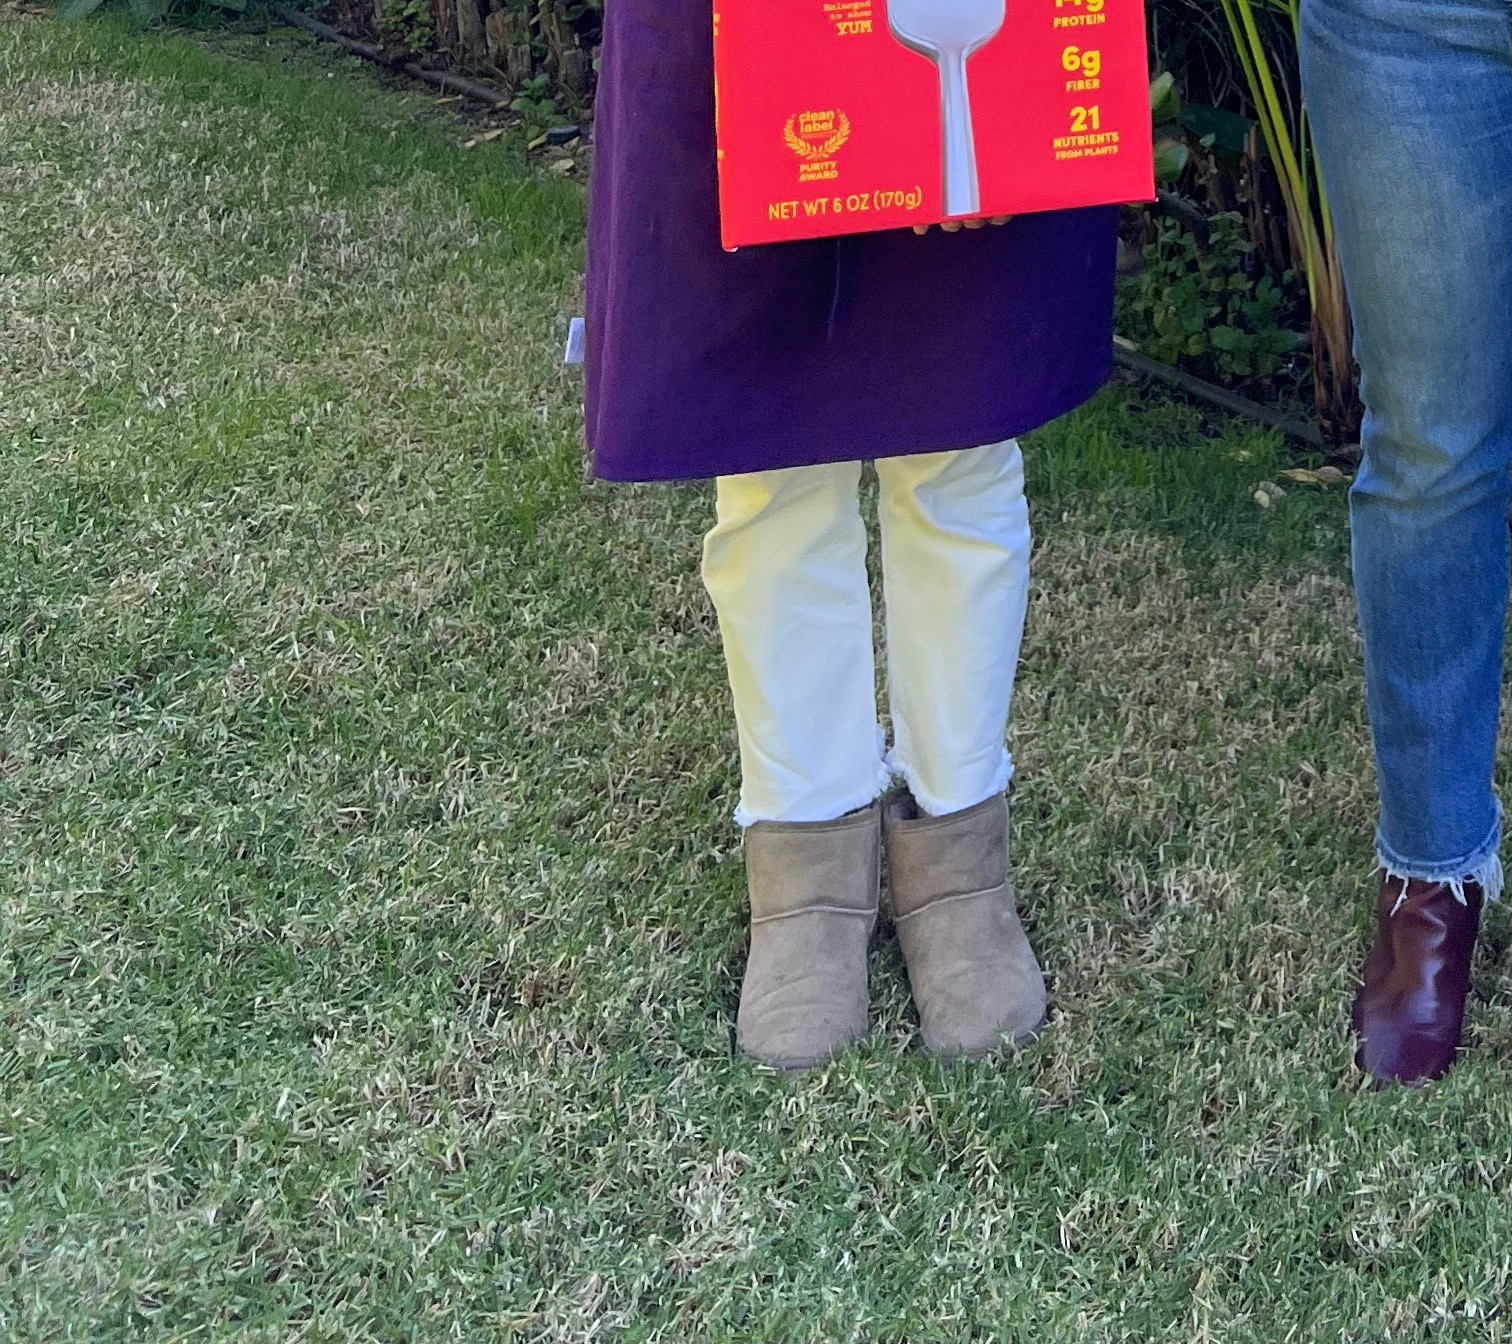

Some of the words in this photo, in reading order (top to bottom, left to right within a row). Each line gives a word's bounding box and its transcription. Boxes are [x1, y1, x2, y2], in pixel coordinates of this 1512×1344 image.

[836, 19, 873, 36] YUM
[1053, 13, 1105, 28] PROTEIN
[1062, 45, 1101, 78] 6g
[1066, 78, 1100, 92] FIBER
[799, 110, 835, 122] clean
[1070, 105, 1100, 133] 21
[800, 119, 833, 132] label
[1053, 132, 1119, 148] NUTRIENTS
[799, 160, 837, 173] PURITY
[799, 170, 839, 182] AWARD
[768, 201, 799, 220] NET
[803, 197, 829, 216] WT
[833, 197, 842, 213] 6
[846, 193, 870, 211] OZ
[873, 185, 922, 211] (170g)
